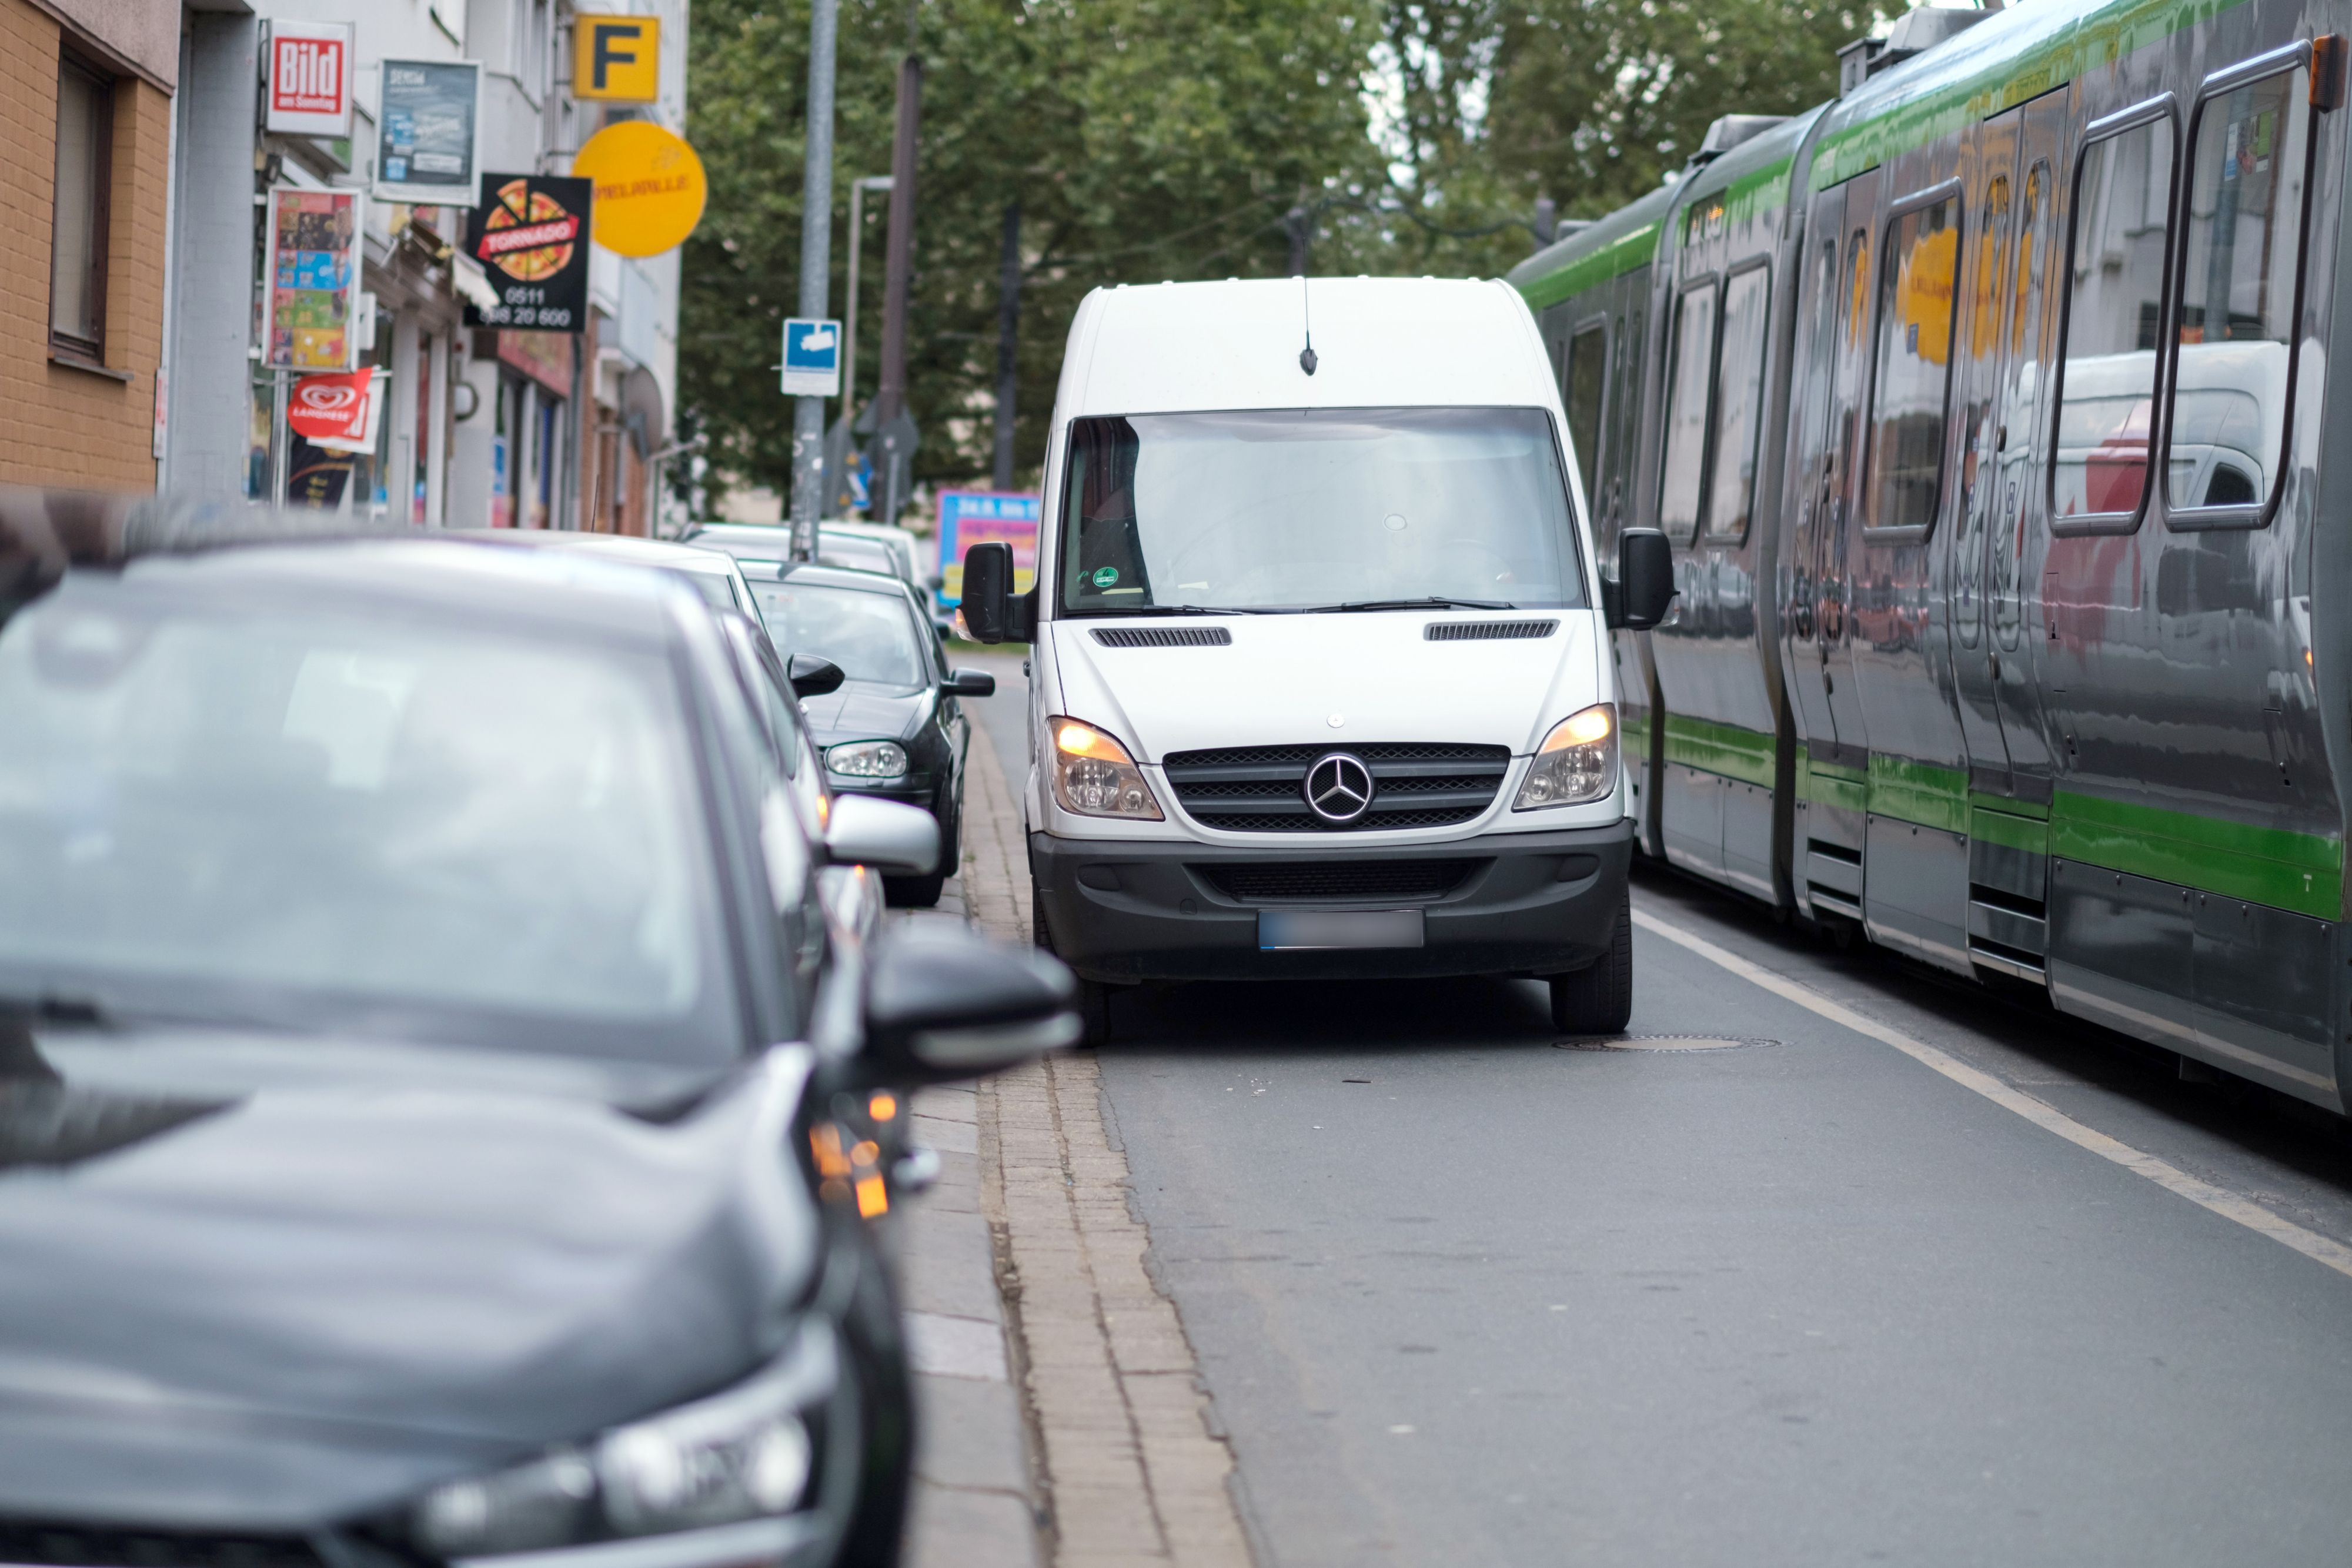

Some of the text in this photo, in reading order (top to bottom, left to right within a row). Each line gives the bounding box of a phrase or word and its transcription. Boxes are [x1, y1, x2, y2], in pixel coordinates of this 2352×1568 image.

[593, 24, 641, 89] F
[279, 42, 337, 96] Bild
[278, 95, 336, 111] am Sonntag
[487, 220, 572, 252] TORNADO
[505, 286, 544, 305] 0511
[513, 307, 536, 325] 20
[539, 308, 572, 327] 600
[293, 407, 349, 422] LANGNESE
[1102, 568, 1110, 576] 4
